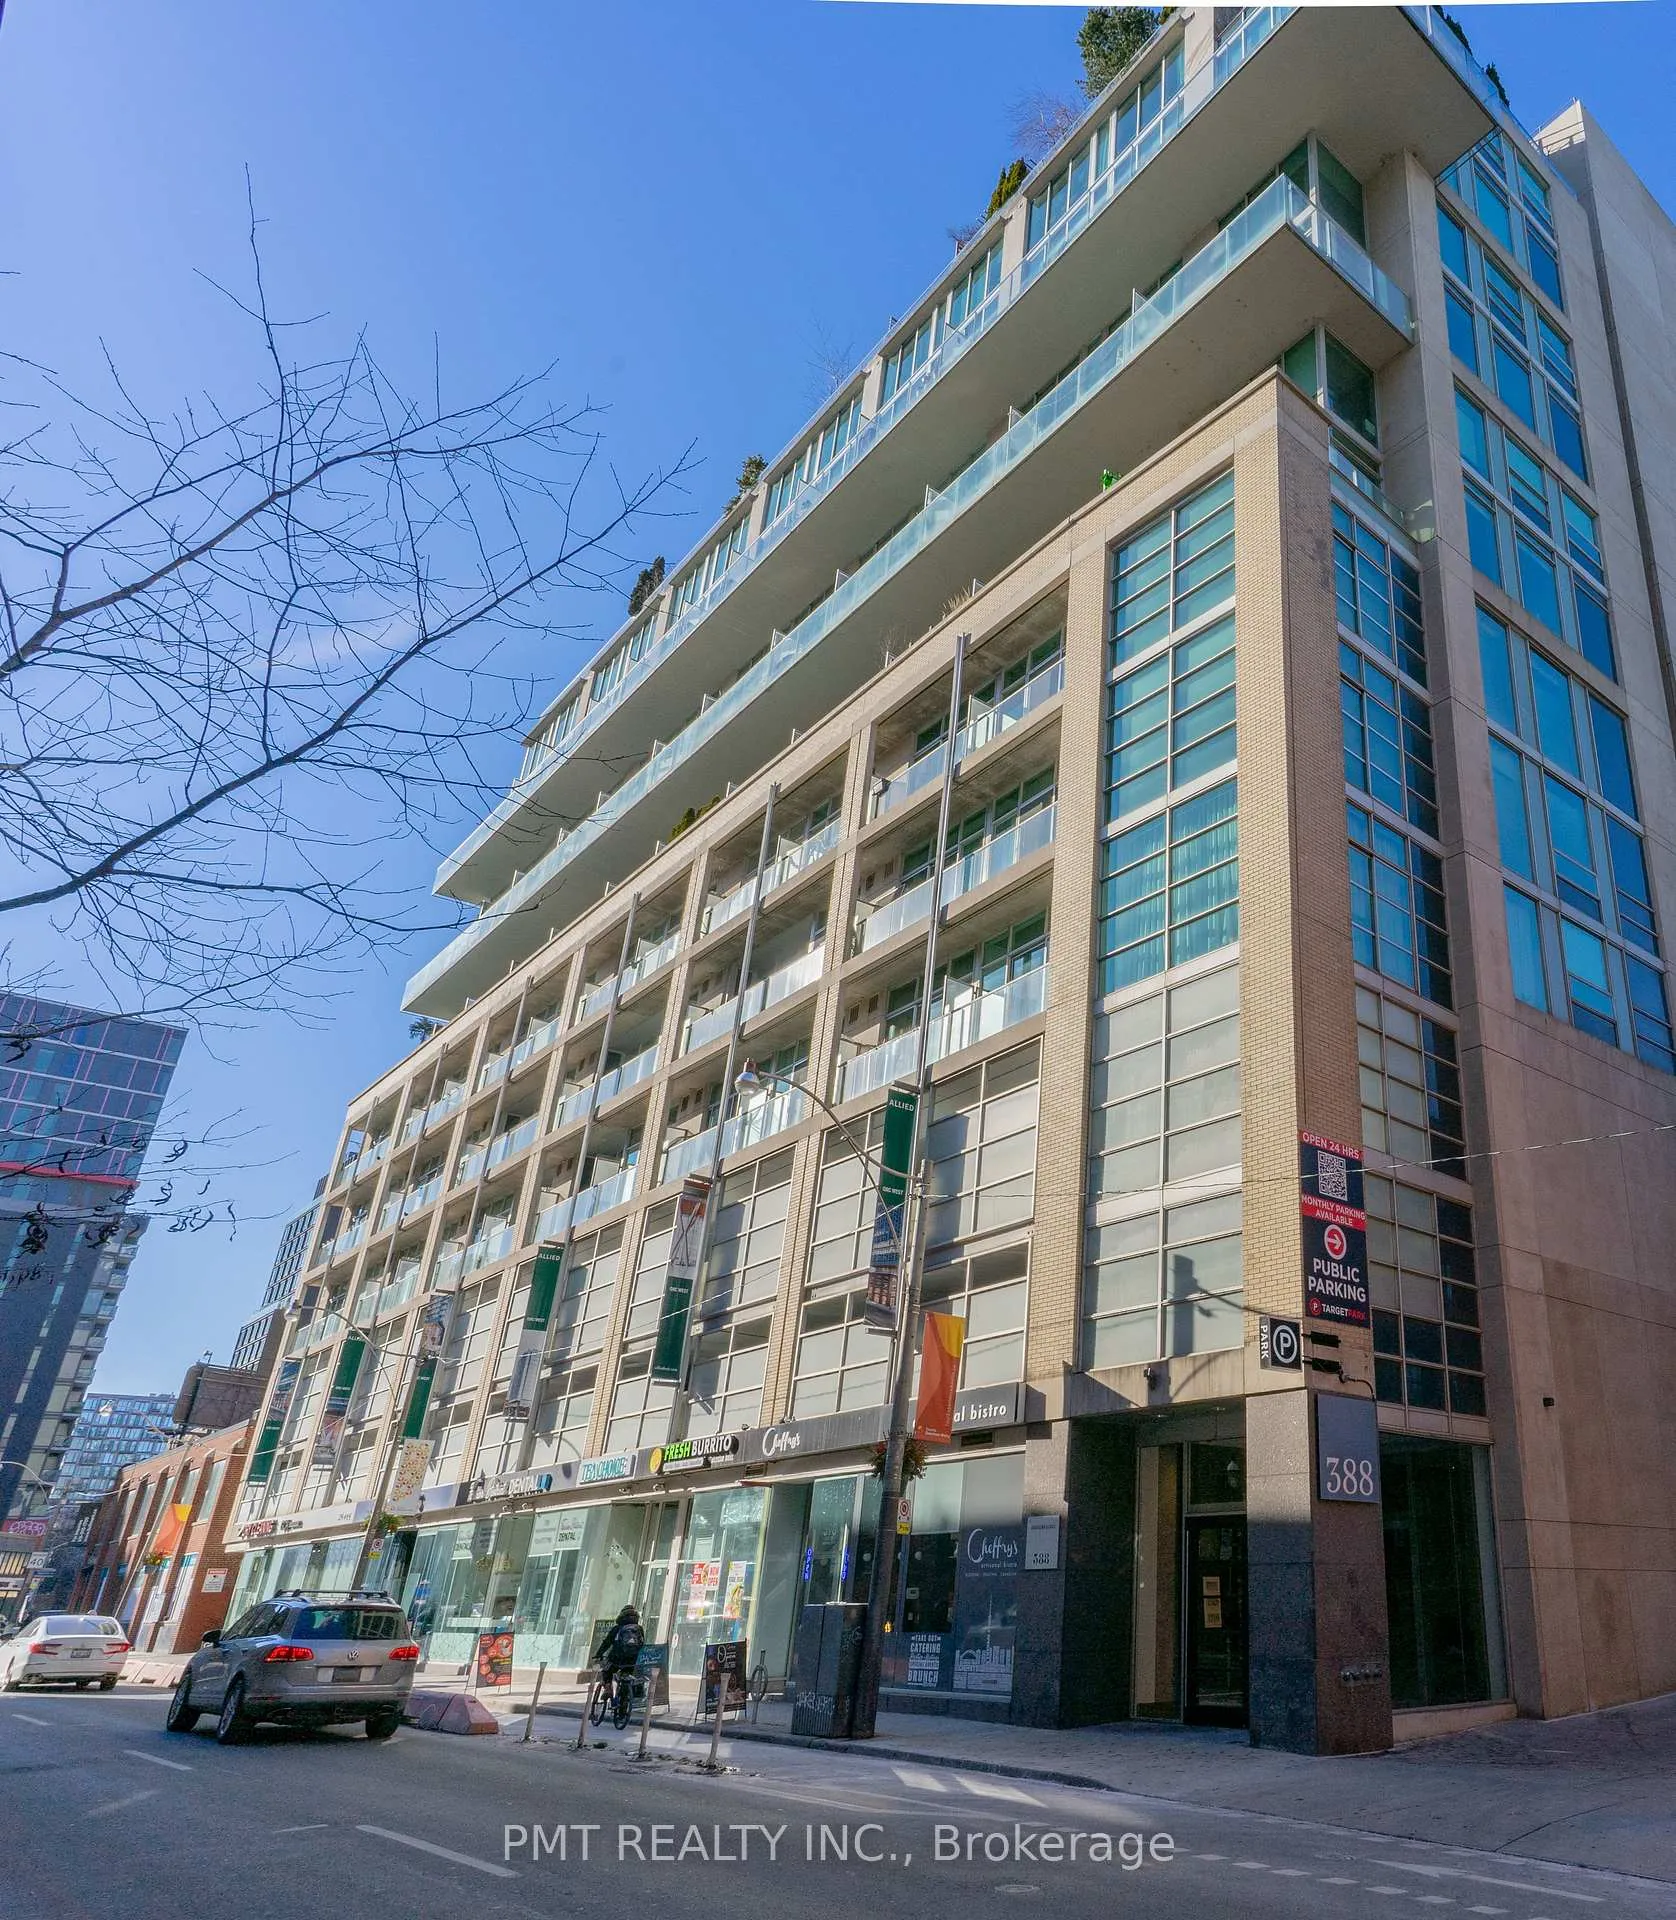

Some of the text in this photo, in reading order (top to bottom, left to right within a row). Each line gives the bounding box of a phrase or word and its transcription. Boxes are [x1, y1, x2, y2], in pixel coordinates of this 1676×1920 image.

[888, 1099, 915, 1112] ALLIED
[1302, 1132, 1361, 1160] OPEN 24 HRS
[1302, 1194, 1366, 1220] MONTHLY PARKING
[1315, 1209, 1354, 1227] AVAILABLE
[538, 1252, 561, 1262] ALLIED
[1313, 1257, 1360, 1283] PUBLIC
[1308, 1275, 1367, 1303] PARKING
[1260, 1324, 1270, 1360] PARK
[1279, 1332, 1293, 1356] P
[970, 1403, 1007, 1421] bistro
[664, 1440, 691, 1461] FRESH
[691, 1434, 733, 1457] BURRITO
[508, 1475, 539, 1495] DENTAL
[1326, 1456, 1374, 1496] 388
[910, 1642, 941, 1654] CATERING
[907, 1669, 939, 1683] BRUNCH
